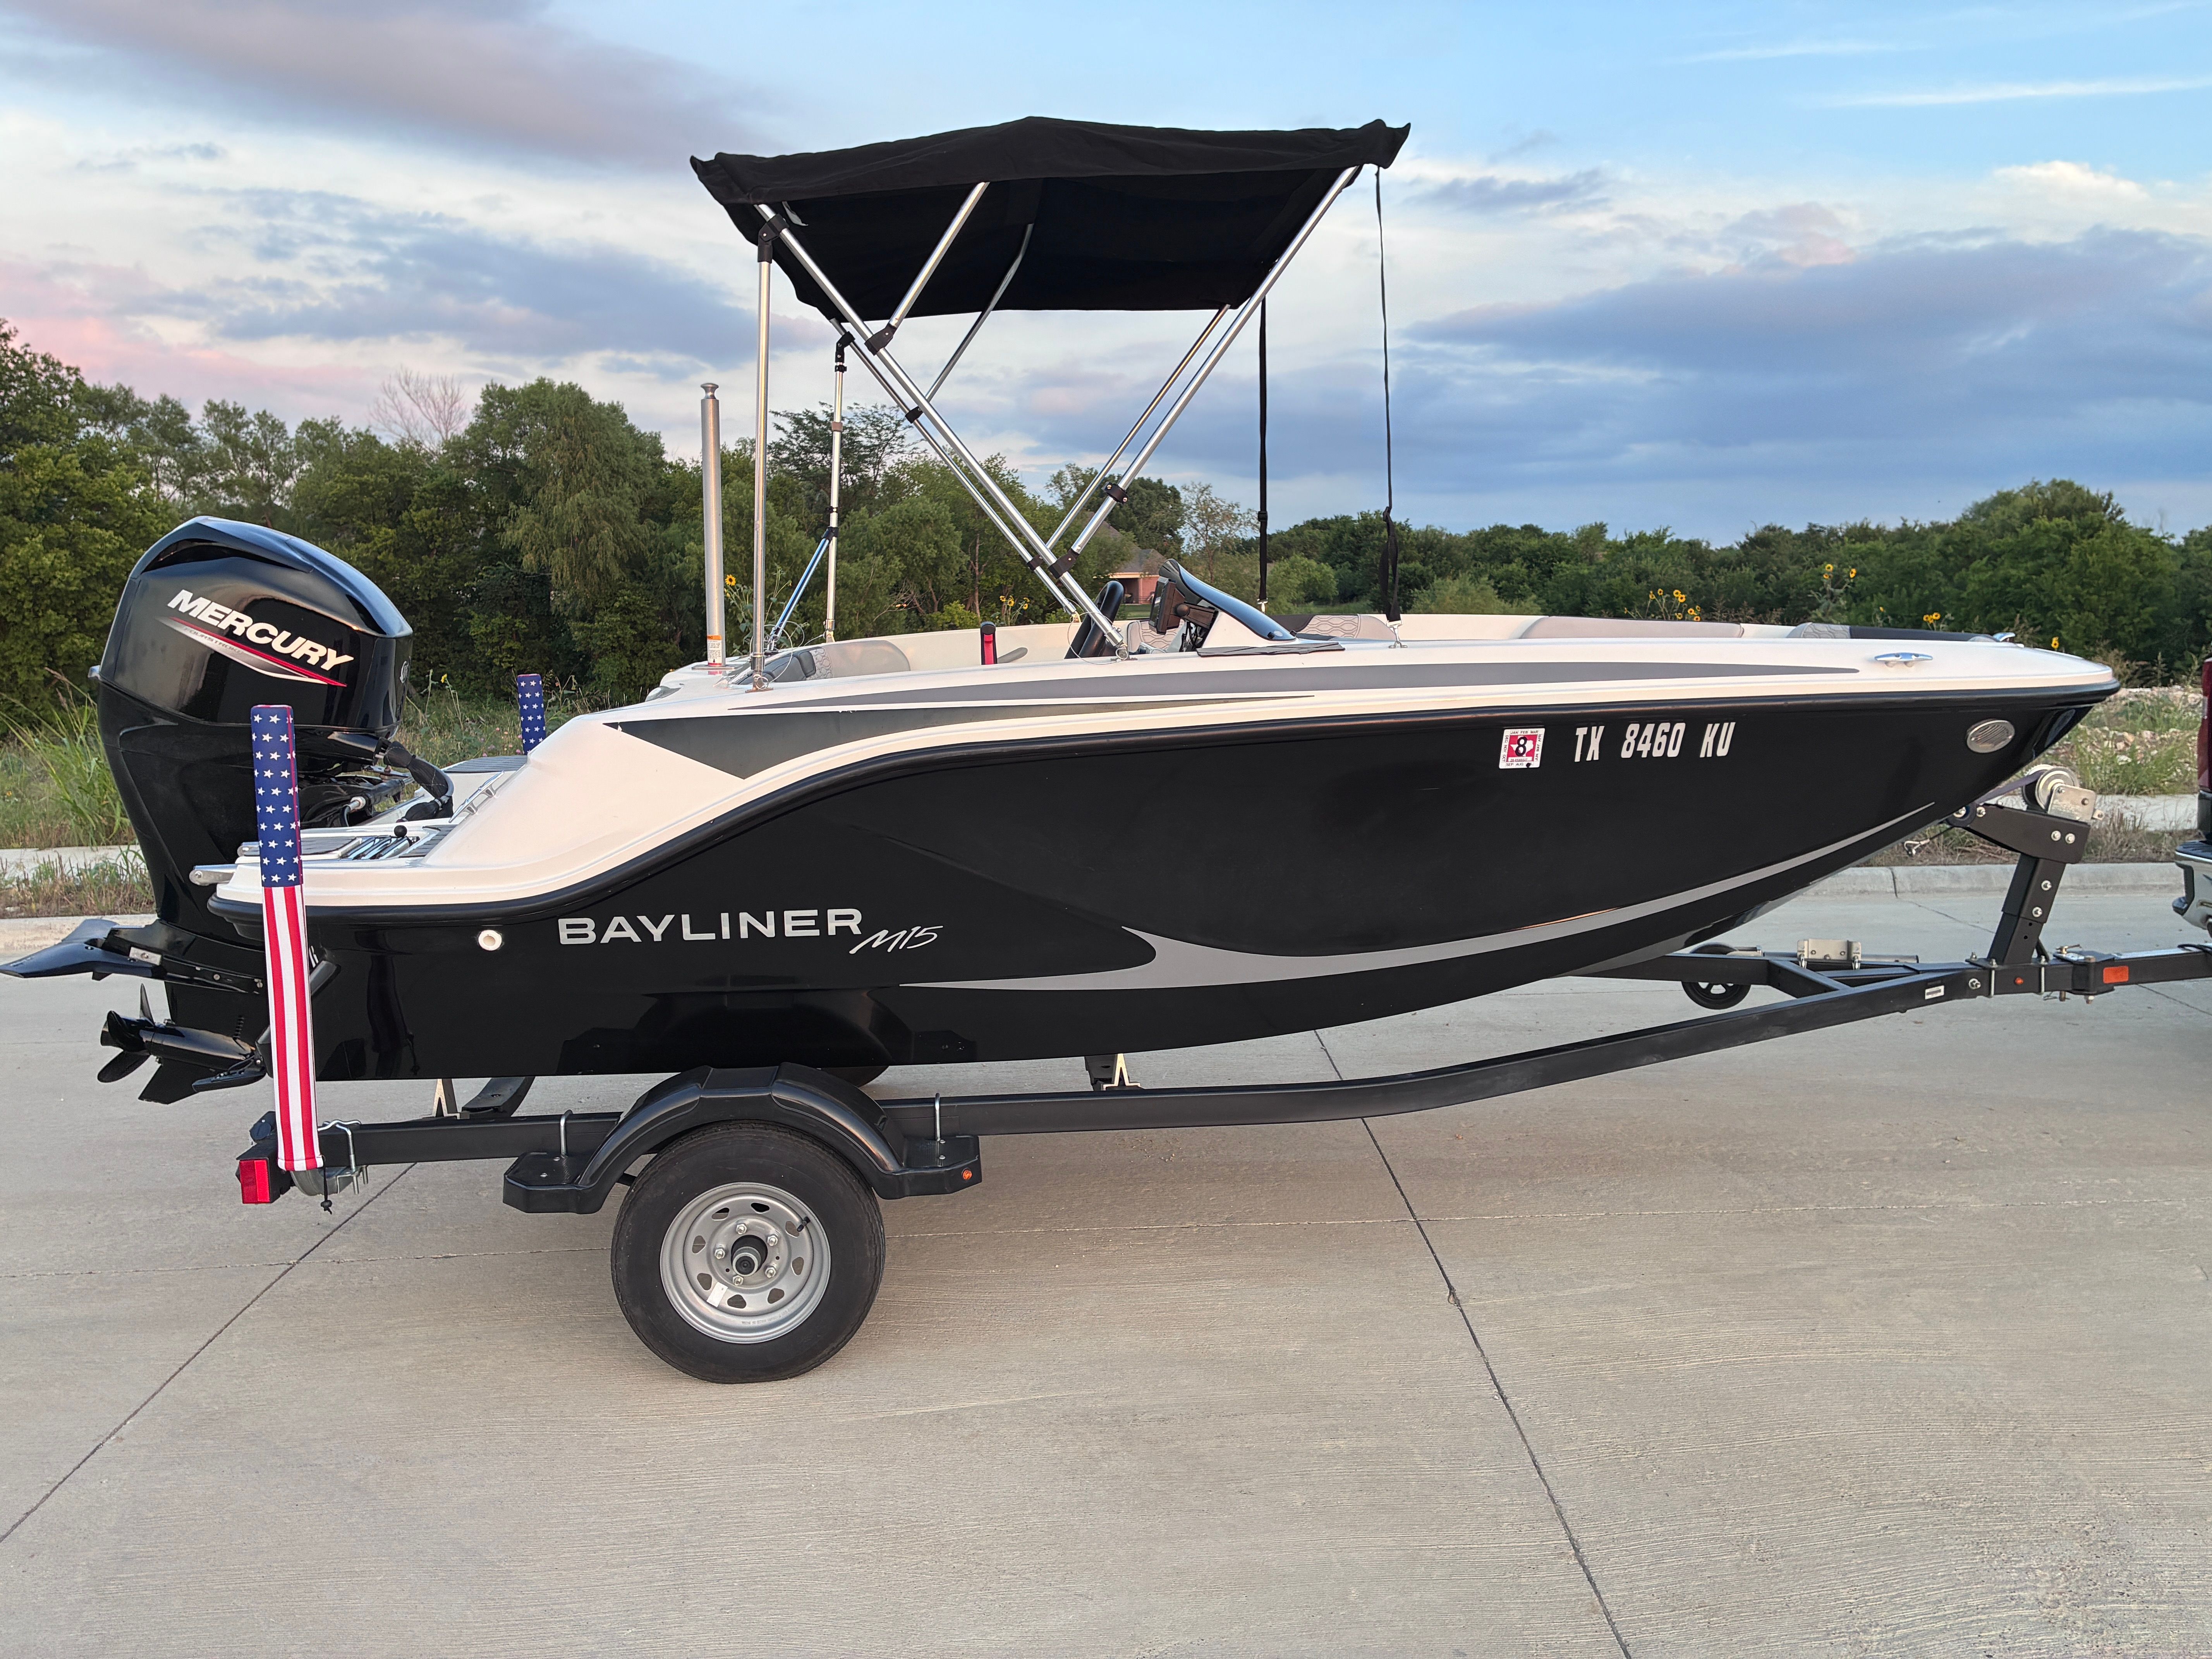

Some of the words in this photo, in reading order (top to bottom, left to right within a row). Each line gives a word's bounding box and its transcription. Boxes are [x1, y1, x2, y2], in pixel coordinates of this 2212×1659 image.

[167, 589, 354, 671] MERCURY
[1515, 736, 1528, 757] 8
[1575, 726, 1605, 762] TX
[1621, 723, 1686, 758] 8460
[1700, 722, 1736, 758] KU
[558, 908, 862, 945] BAYLINER
[849, 926, 943, 954] M15
